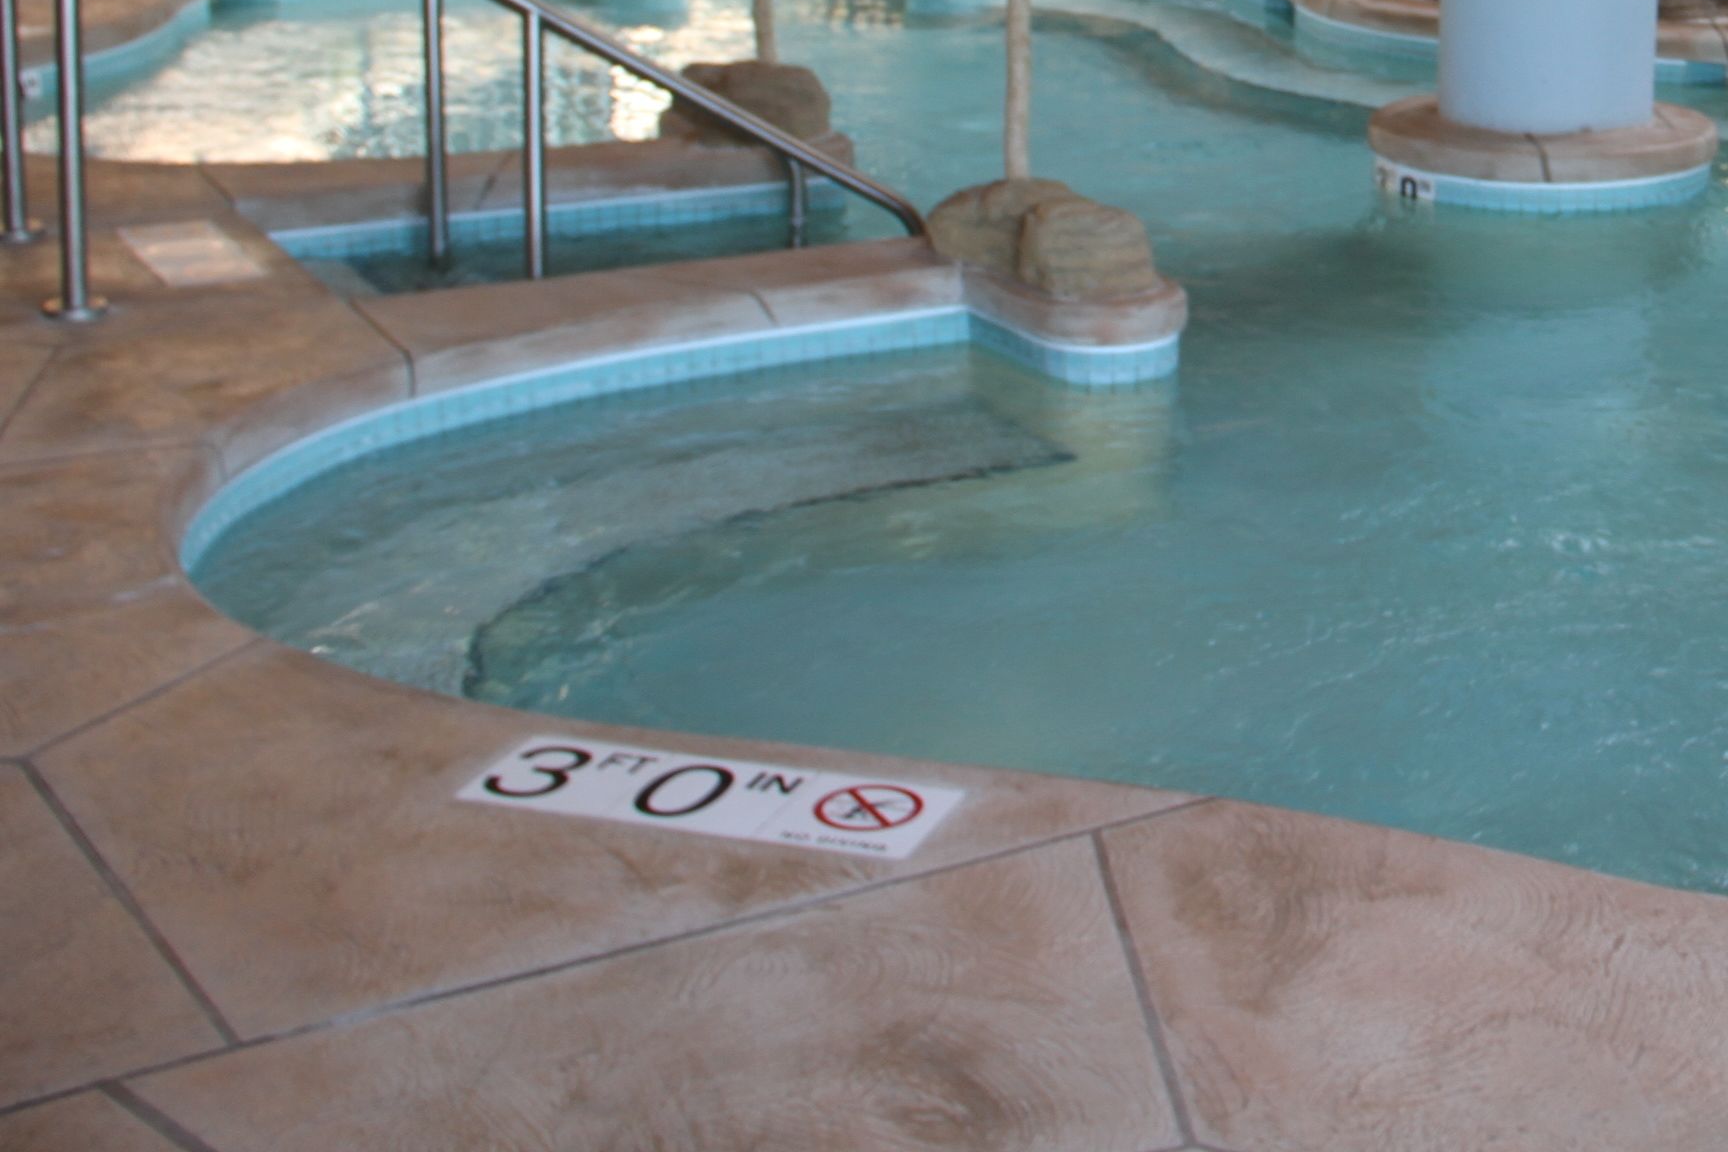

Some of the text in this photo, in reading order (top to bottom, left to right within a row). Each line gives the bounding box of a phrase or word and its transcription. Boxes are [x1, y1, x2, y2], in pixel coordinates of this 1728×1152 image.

[483, 746, 804, 817] 3 FT 0 IN
